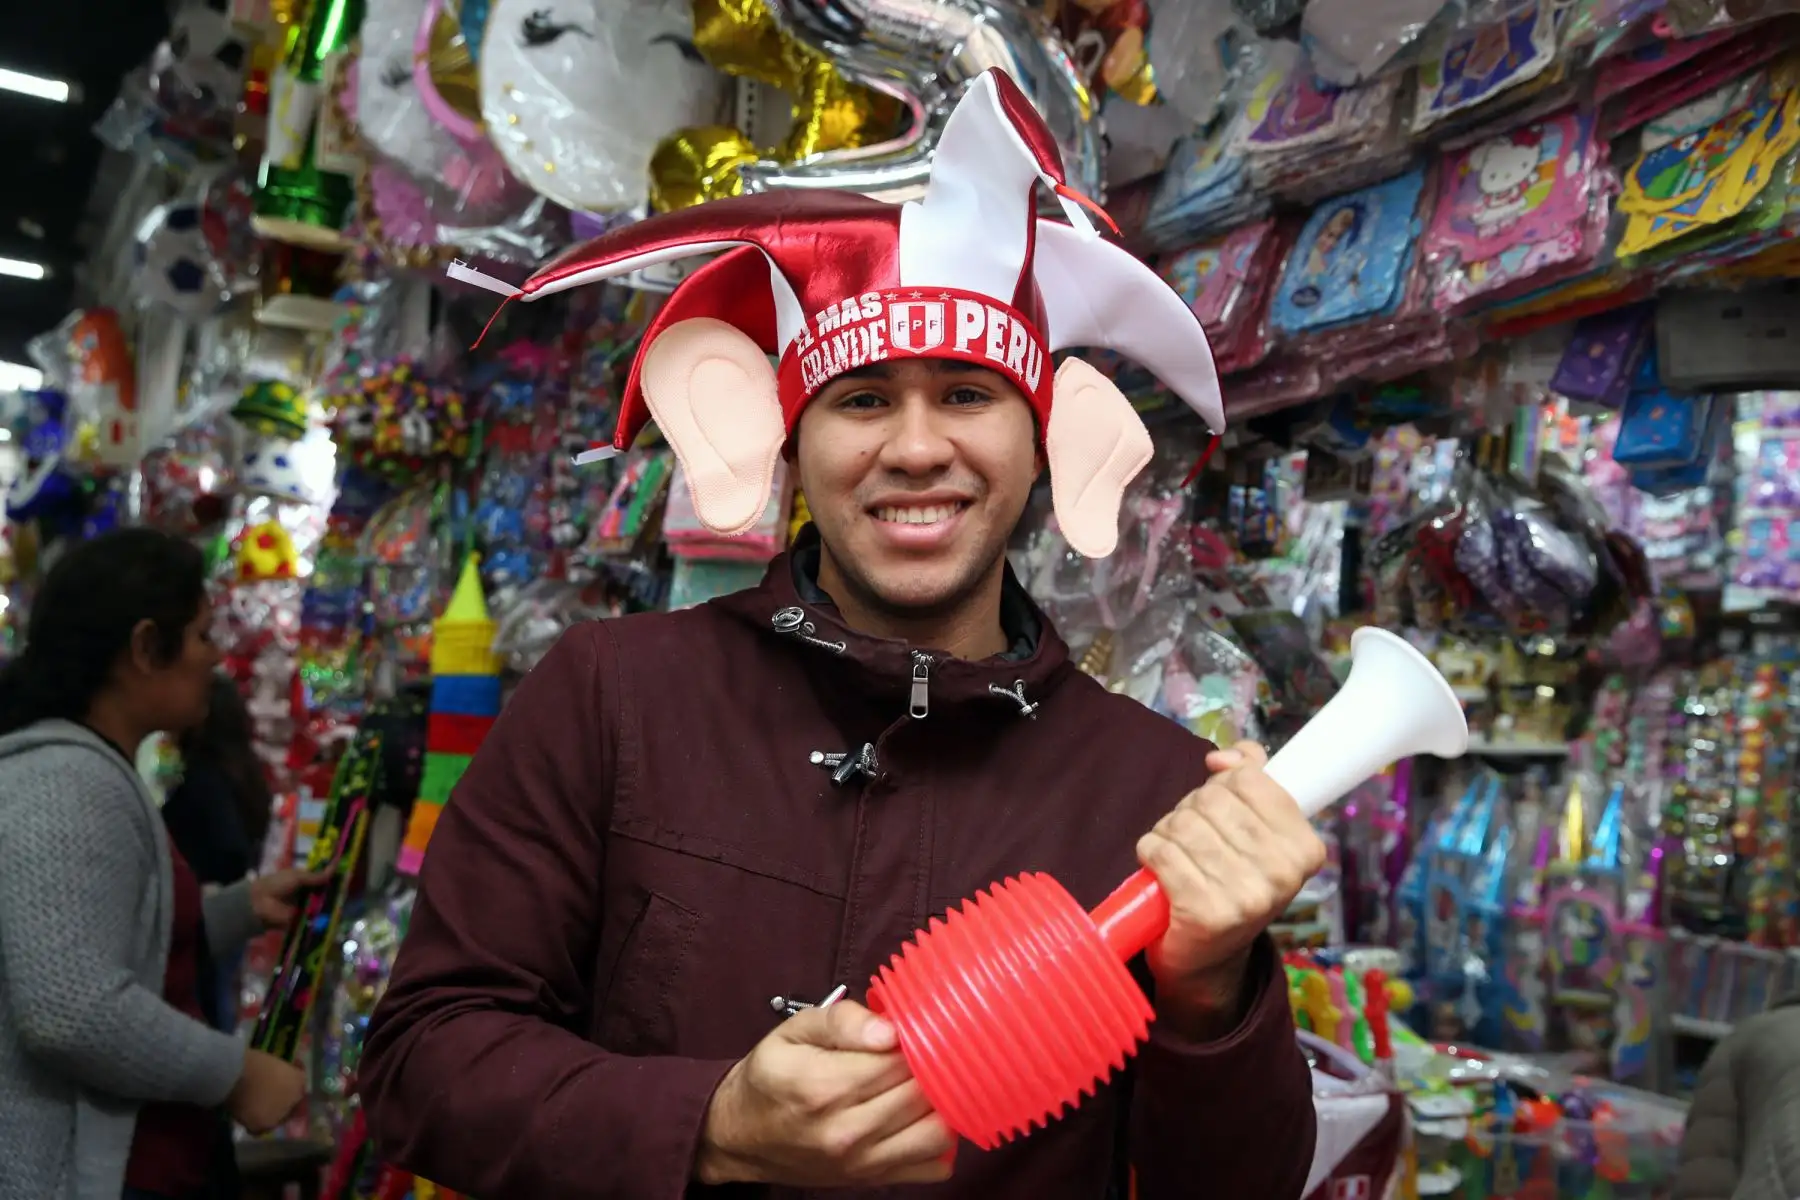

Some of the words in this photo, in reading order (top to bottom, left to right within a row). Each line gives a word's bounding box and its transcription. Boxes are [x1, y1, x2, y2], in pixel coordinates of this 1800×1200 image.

[815, 291, 883, 337] MAS
[953, 298, 1043, 394] PERU
[801, 318, 888, 395] GRANDE
